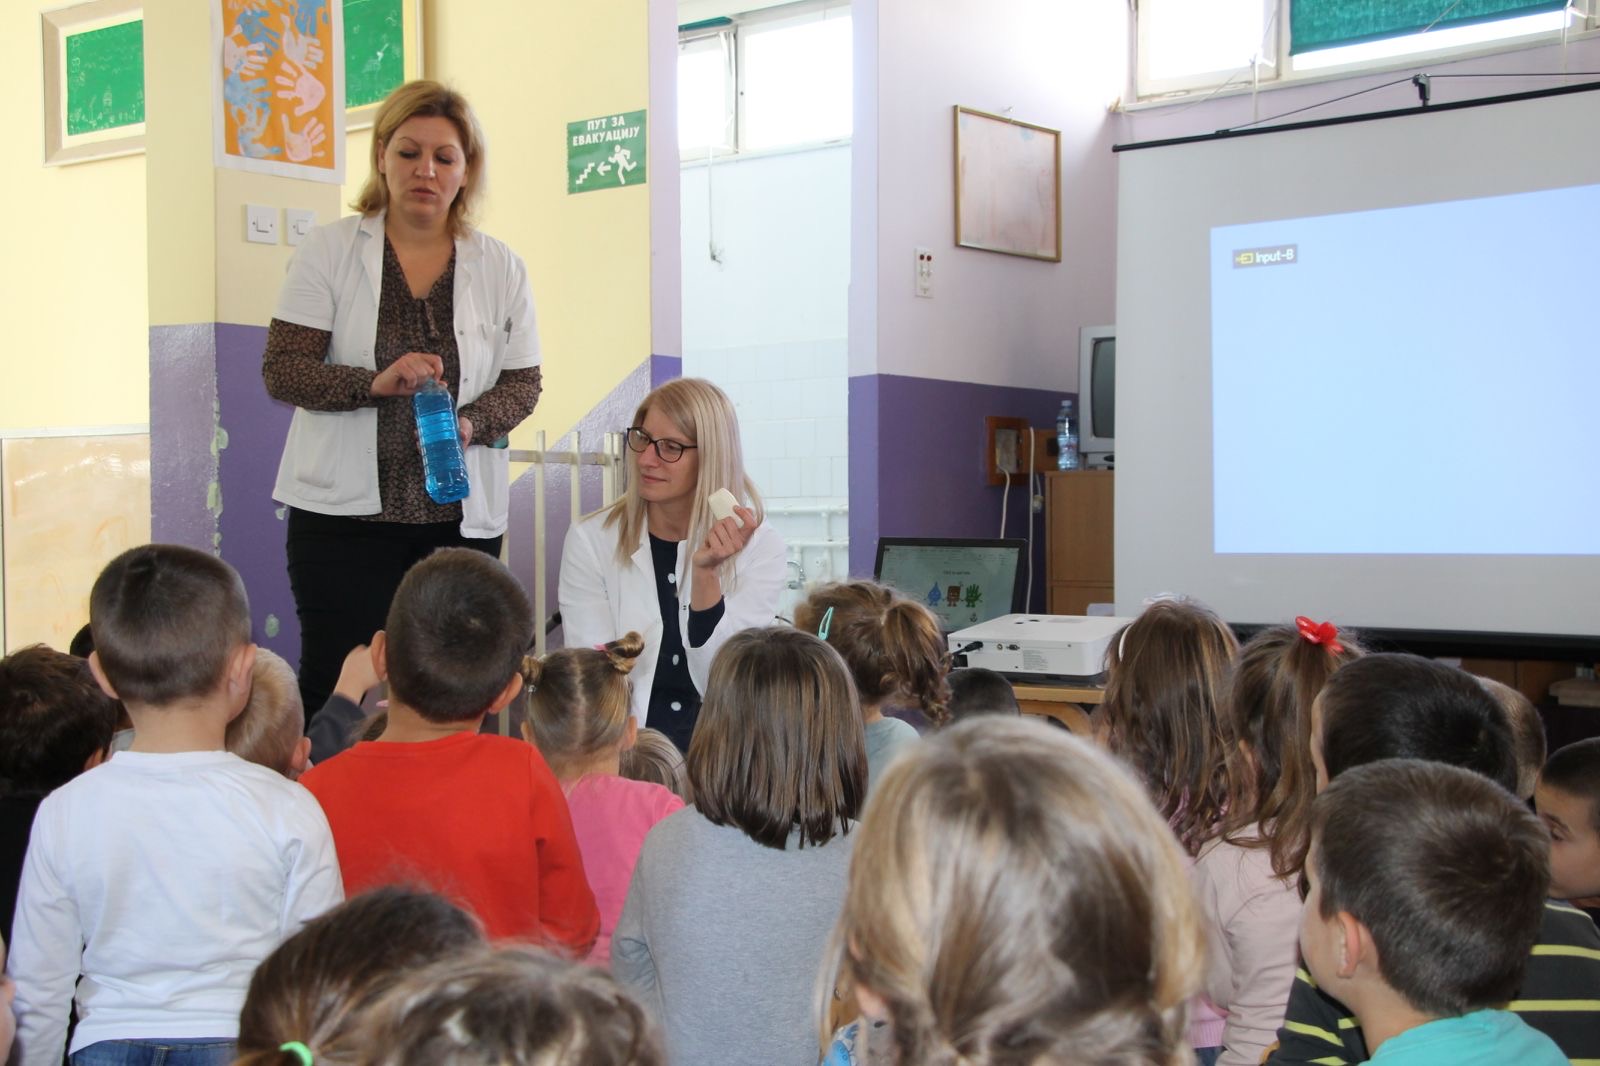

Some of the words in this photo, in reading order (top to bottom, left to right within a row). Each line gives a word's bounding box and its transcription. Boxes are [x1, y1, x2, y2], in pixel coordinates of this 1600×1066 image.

[587, 119, 607, 131] ПУТ
[611, 116, 625, 127] ЗА
[573, 126, 640, 147] ЕВАКУАЦИЈУ
[1255, 248, 1294, 265] Input-B
